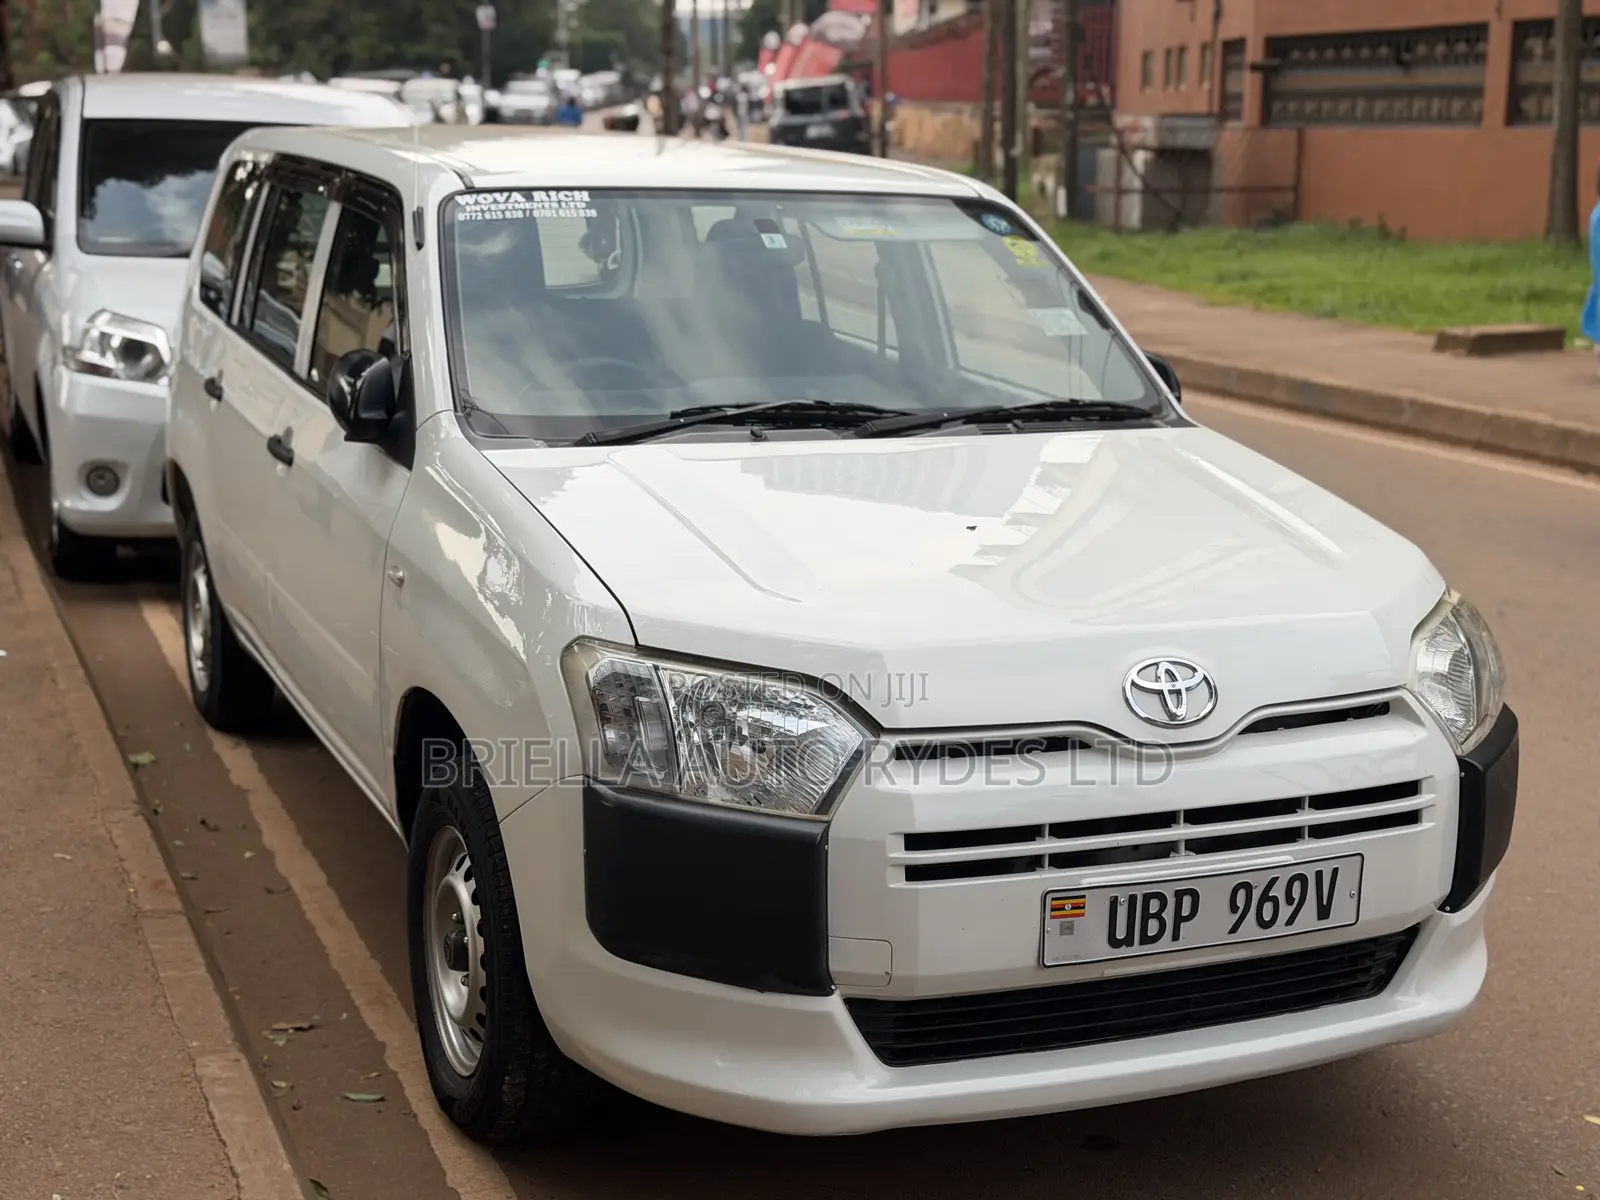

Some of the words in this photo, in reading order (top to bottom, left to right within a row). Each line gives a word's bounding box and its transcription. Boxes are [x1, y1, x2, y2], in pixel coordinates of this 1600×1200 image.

[455, 191, 526, 205] WOVA
[532, 190, 591, 202] RICH
[465, 202, 559, 212] INVESTMENTS
[560, 201, 586, 209] LTD
[458, 211, 484, 221] 0772
[1107, 886, 1200, 949] UBP
[1227, 866, 1340, 935] 969V
